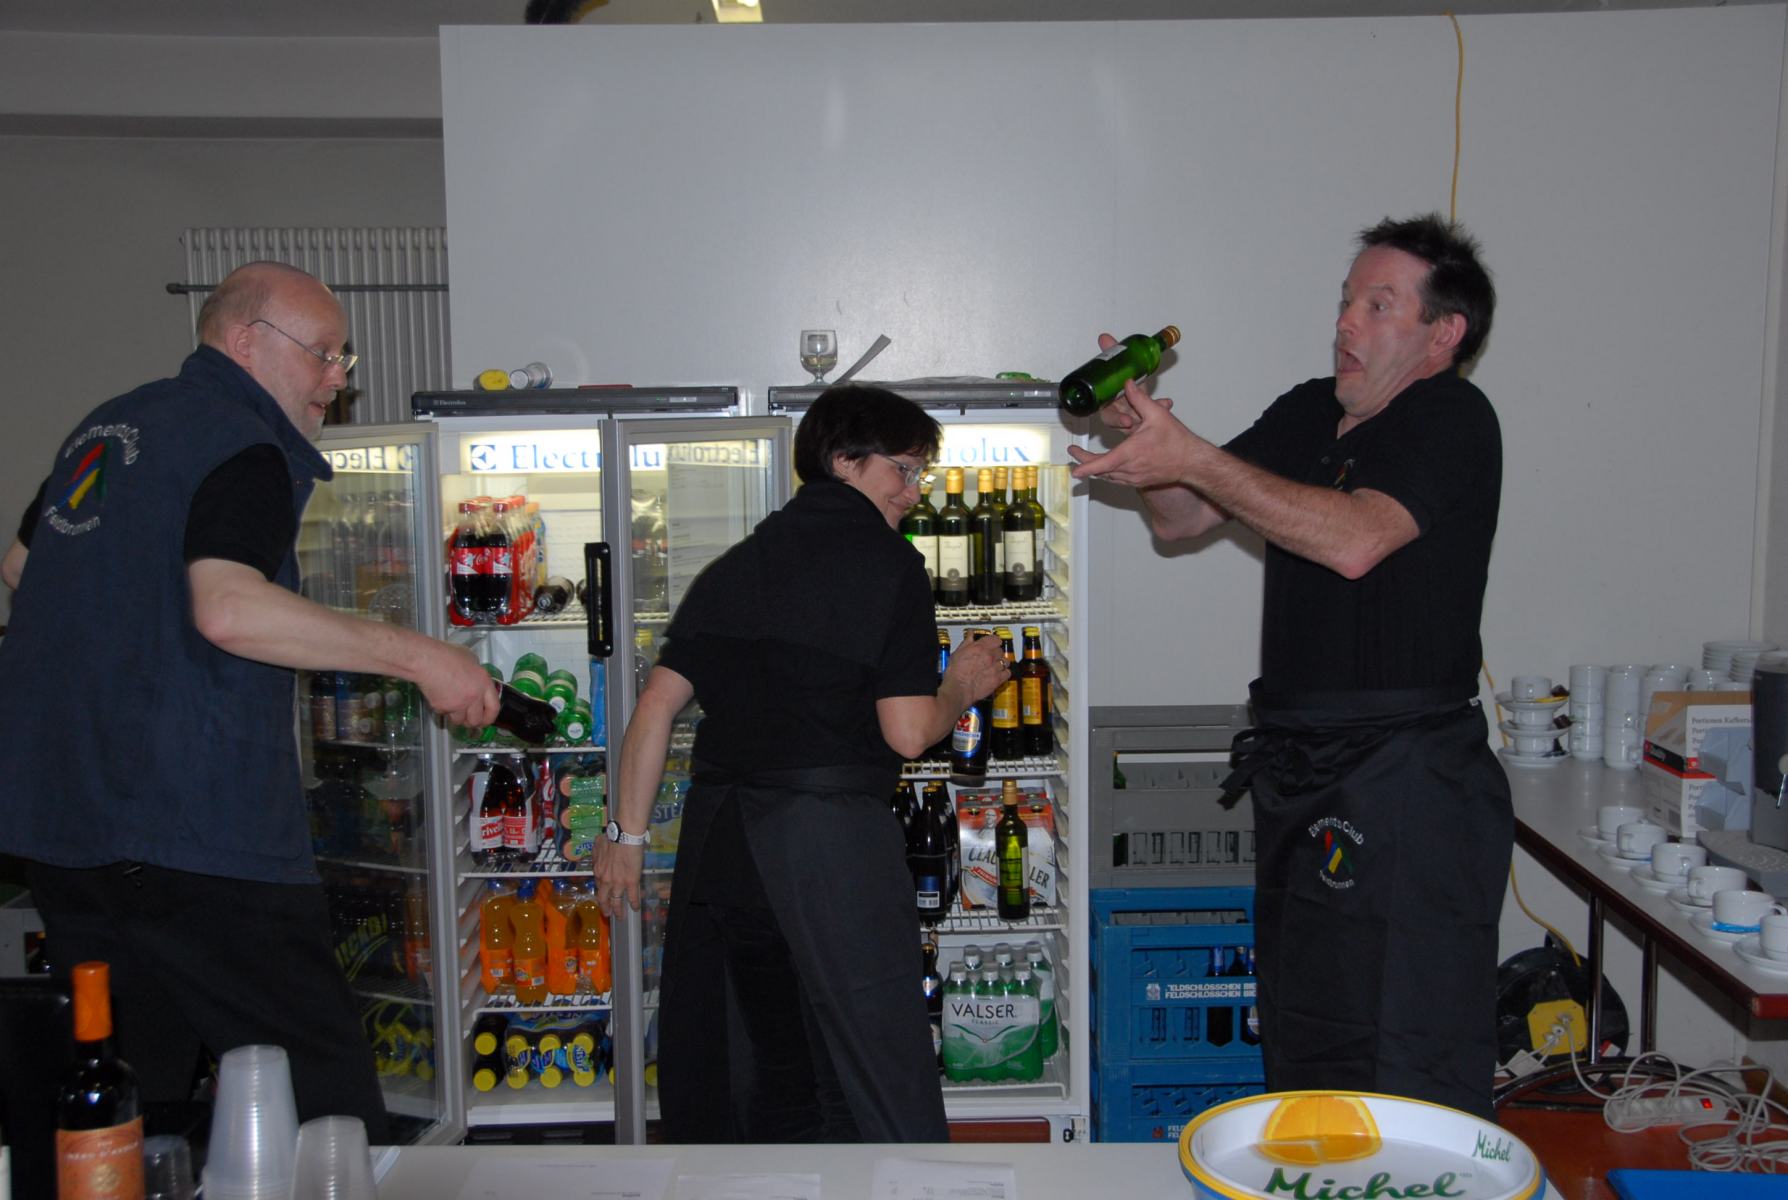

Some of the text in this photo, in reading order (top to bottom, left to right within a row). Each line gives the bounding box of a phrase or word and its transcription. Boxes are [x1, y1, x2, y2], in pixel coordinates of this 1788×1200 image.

[946, 437, 1031, 463] rolux
[1342, 820, 1364, 845] Club
[951, 1003, 1015, 1019] VALSER
[1472, 1128, 1513, 1162] Michel
[1262, 1167, 1467, 1200] Michel
